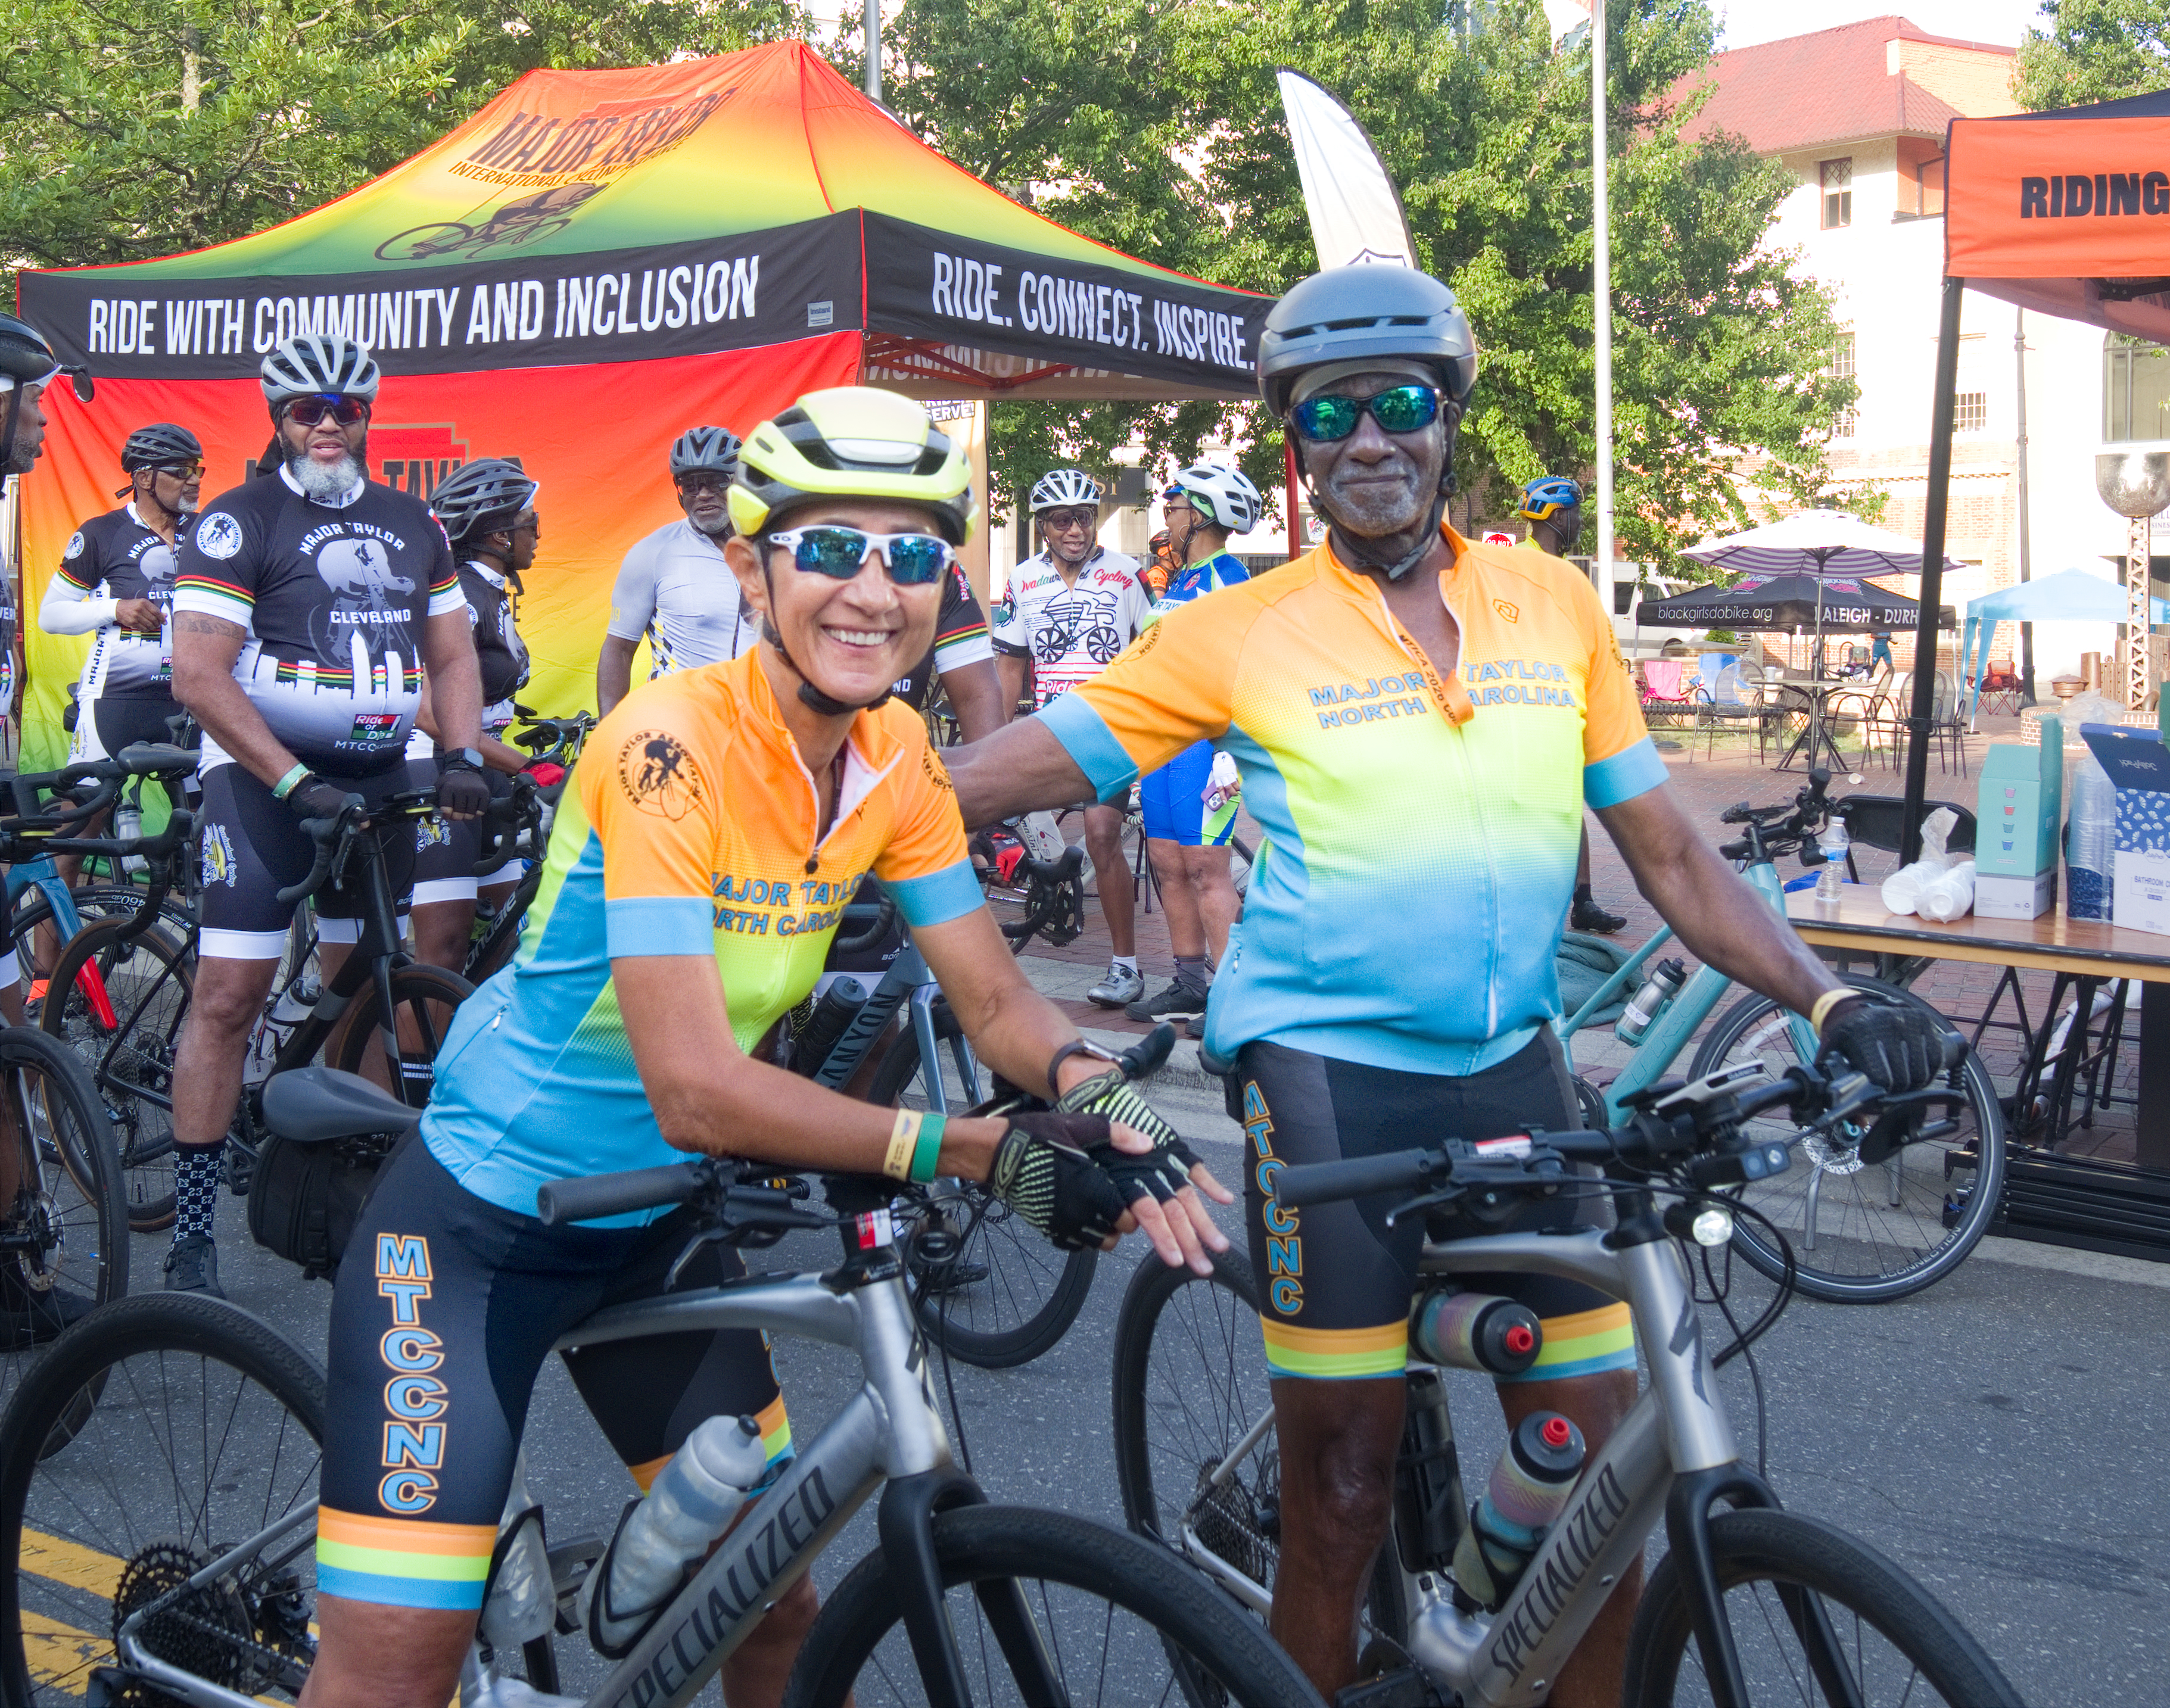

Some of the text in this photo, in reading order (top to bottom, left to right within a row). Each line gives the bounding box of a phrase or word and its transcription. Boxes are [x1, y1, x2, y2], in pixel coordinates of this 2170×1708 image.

[466, 111, 621, 173] MAJOR
[448, 161, 565, 188] INTERNATIONAL
[2020, 171, 2170, 219] RIDING
[89, 255, 759, 355] RIDE WITH COMMUNITY AND INCLUSION
[932, 252, 1012, 327] RIDE.
[1019, 271, 1149, 351] CONNECT.
[1154, 300, 1255, 370] INSPIRE.
[300, 523, 344, 555] MAJOR
[345, 522, 405, 551] TAYLOR
[1094, 569, 1134, 590] Cycling
[330, 609, 411, 624] CLEVELAND
[1658, 605, 1773, 622] blackgirlsdobike.org
[1309, 660, 1569, 706] MAJOR TAYLOR
[356, 715, 384, 724] Ride
[1318, 685, 1576, 729] NORTH AROLINA
[334, 740, 376, 752] MTCC
[619, 732, 651, 763] TAYLOR
[619, 769, 641, 805] MAJOR
[712, 872, 791, 906] AJOR
[712, 906, 770, 934] RTH
[821, 992, 899, 1090] ANYON
[1243, 1080, 1303, 1316] MTCCNC
[376, 1233, 449, 1514] MTCCNC
[1491, 1462, 1630, 1688] SPECIALIZED
